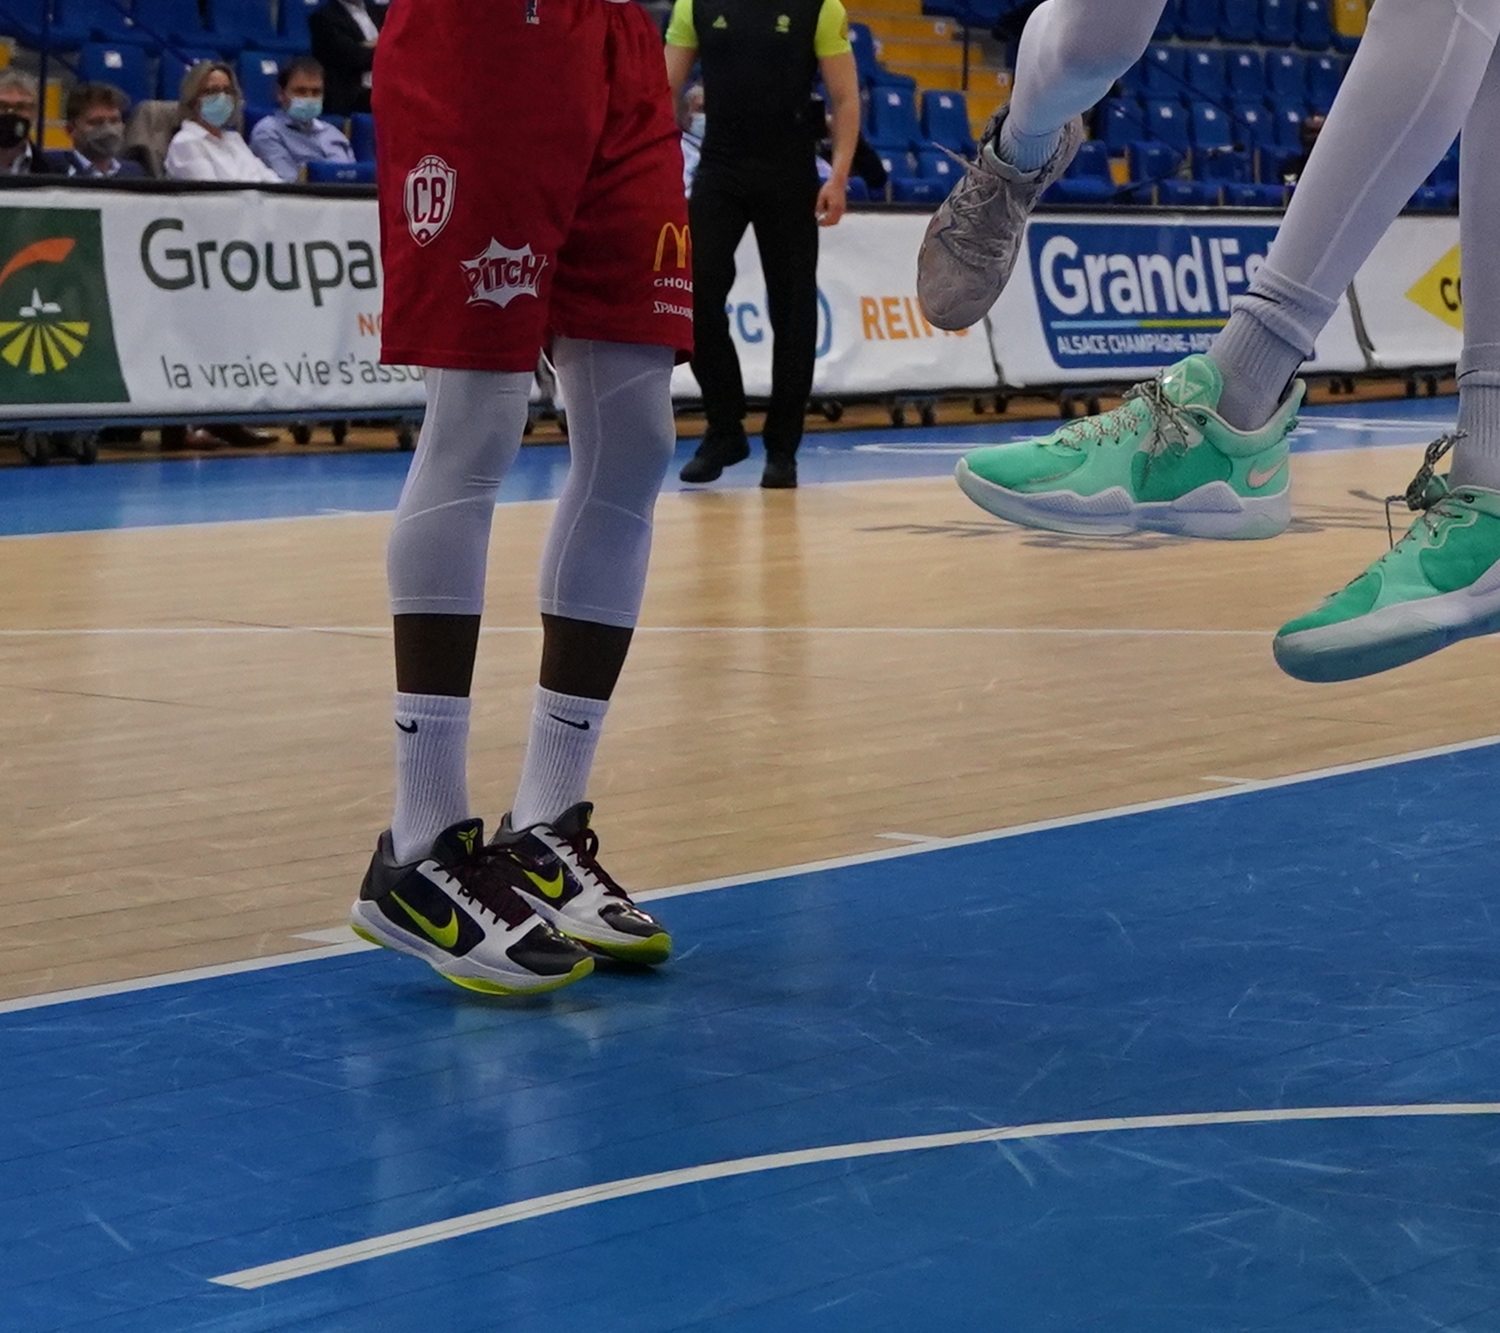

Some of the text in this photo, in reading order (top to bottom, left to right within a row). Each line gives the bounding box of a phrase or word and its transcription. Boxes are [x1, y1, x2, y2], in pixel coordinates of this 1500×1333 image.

[412, 177, 446, 223] CB
[140, 218, 377, 307] Groupa
[653, 278, 693, 292] CHOL
[1039, 235, 1210, 316] Grand
[861, 295, 970, 341] REI
[1057, 335, 1104, 354] ALSACE
[161, 352, 425, 389] la vraie vie s'assu
